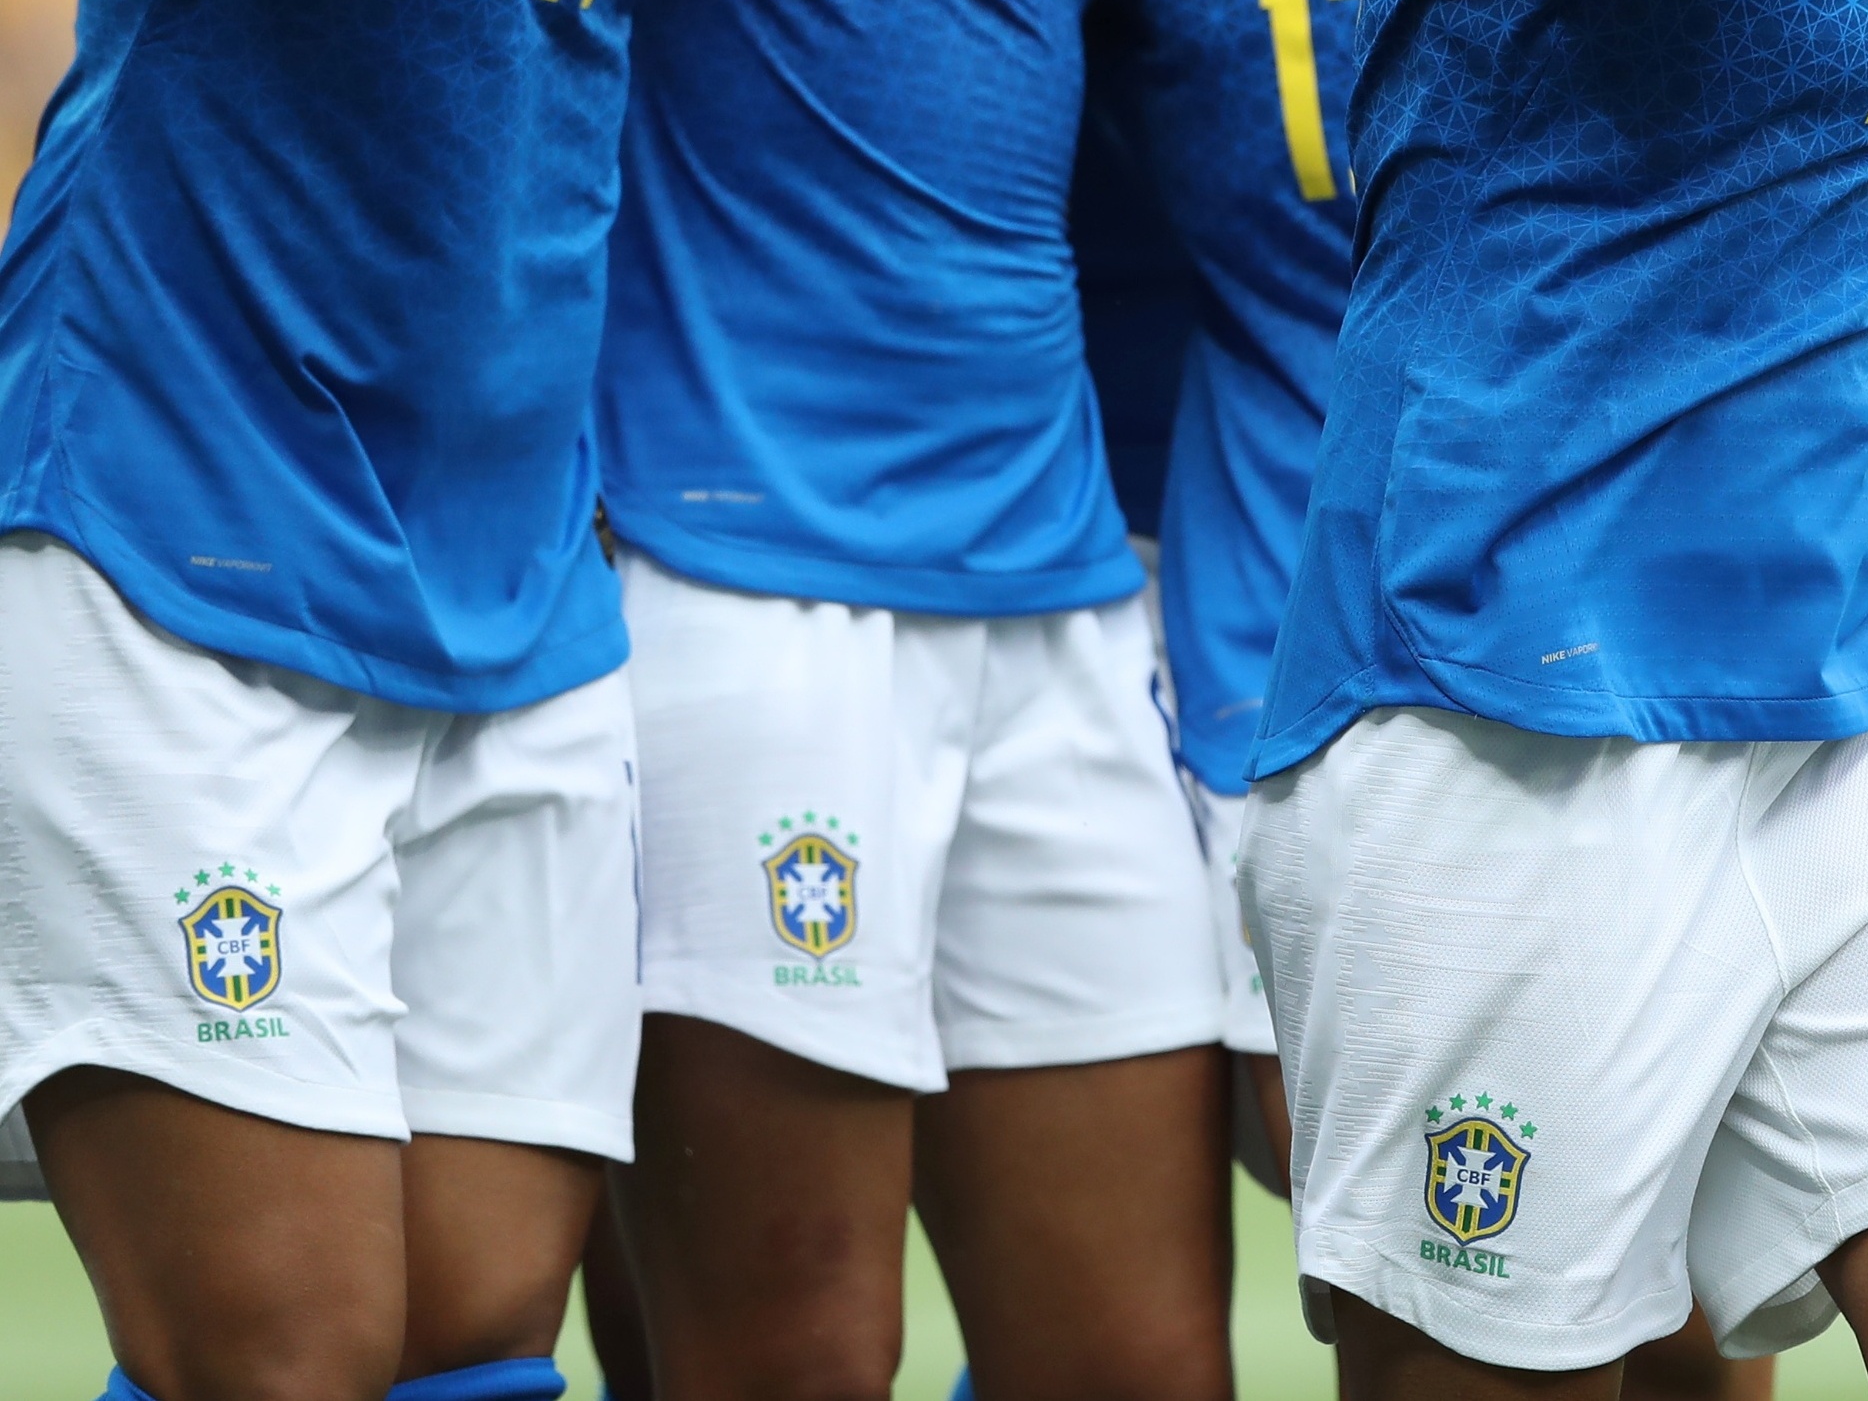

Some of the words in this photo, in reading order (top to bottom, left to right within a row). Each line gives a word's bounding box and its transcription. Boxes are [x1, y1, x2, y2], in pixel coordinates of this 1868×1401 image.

[1541, 649, 1567, 665] NIKE
[217, 939, 251, 955] CBF
[774, 963, 862, 986] BRASIL
[196, 1016, 290, 1043] BRASIL
[1456, 1168, 1492, 1186] CBF
[1420, 1239, 1510, 1279] BRASIL
